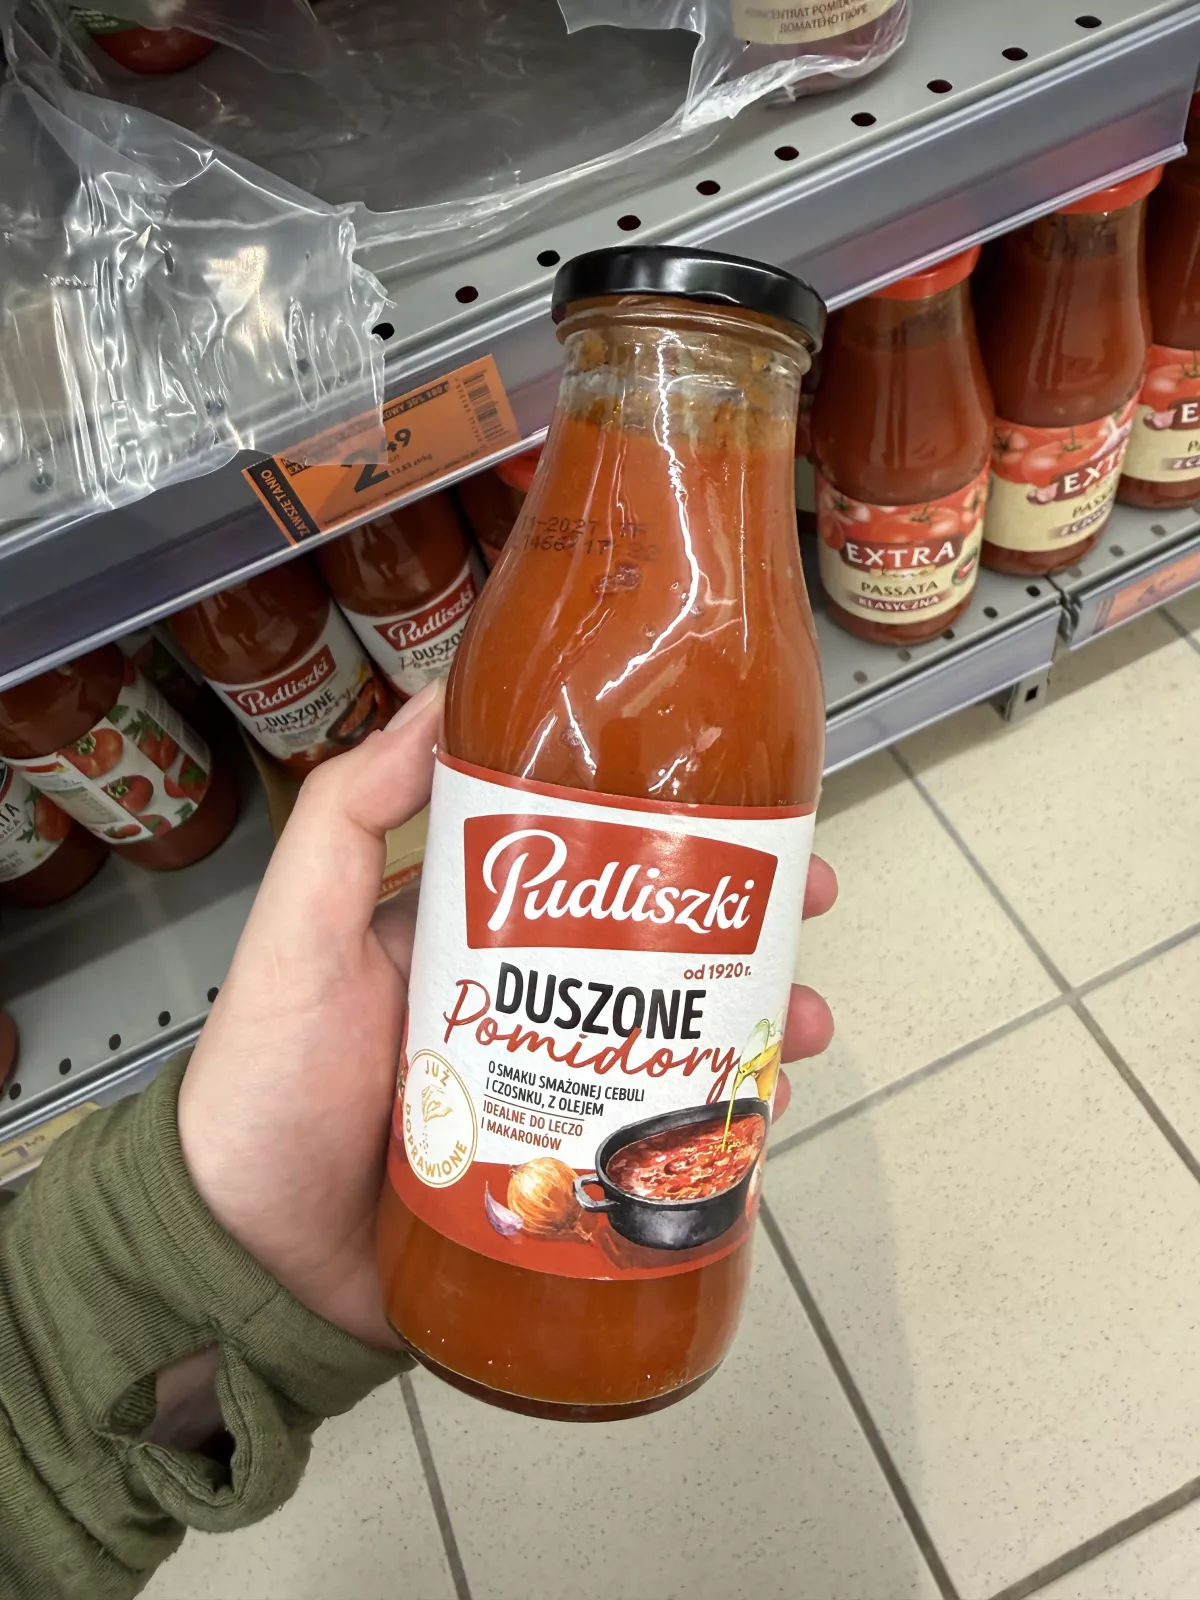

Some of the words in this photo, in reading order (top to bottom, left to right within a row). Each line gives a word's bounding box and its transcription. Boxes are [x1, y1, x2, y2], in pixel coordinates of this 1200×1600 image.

[259, 467, 286, 501] TANIO
[279, 498, 311, 537] ZAWSZE
[845, 540, 957, 568] EXTRA
[857, 595, 940, 611] KLASYCZNA
[860, 580, 939, 597] PASSATA
[388, 583, 474, 647] Pudliszki
[412, 628, 464, 661] DUSZO
[237, 656, 330, 714] Pudliszki
[264, 688, 336, 727] DUSZONE
[482, 829, 755, 934] Pudliszki
[684, 965, 705, 980] od
[708, 962, 743, 979] 1920
[743, 964, 752, 977] r.
[495, 962, 706, 1039] DUSZONE
[443, 979, 741, 1105] Pomidory
[424, 1059, 451, 1087] JUŻ
[488, 1060, 497, 1075] O
[497, 1063, 537, 1087] SMAKU
[538, 1074, 603, 1100] SMAŻONEJ
[604, 1086, 646, 1102] CEBULI
[486, 1077, 491, 1090] I
[491, 1079, 547, 1109] CZOSNKU,
[548, 1095, 557, 1109] Z
[557, 1096, 605, 1117] OLEJEM
[480, 1116, 486, 1130] I
[486, 1119, 563, 1151] MAKARONÓW
[483, 1099, 527, 1125] IDEALNE
[528, 1113, 546, 1130] DO
[547, 1118, 584, 1138] LECZO
[405, 1102, 469, 1178] DOPRAWIONE
